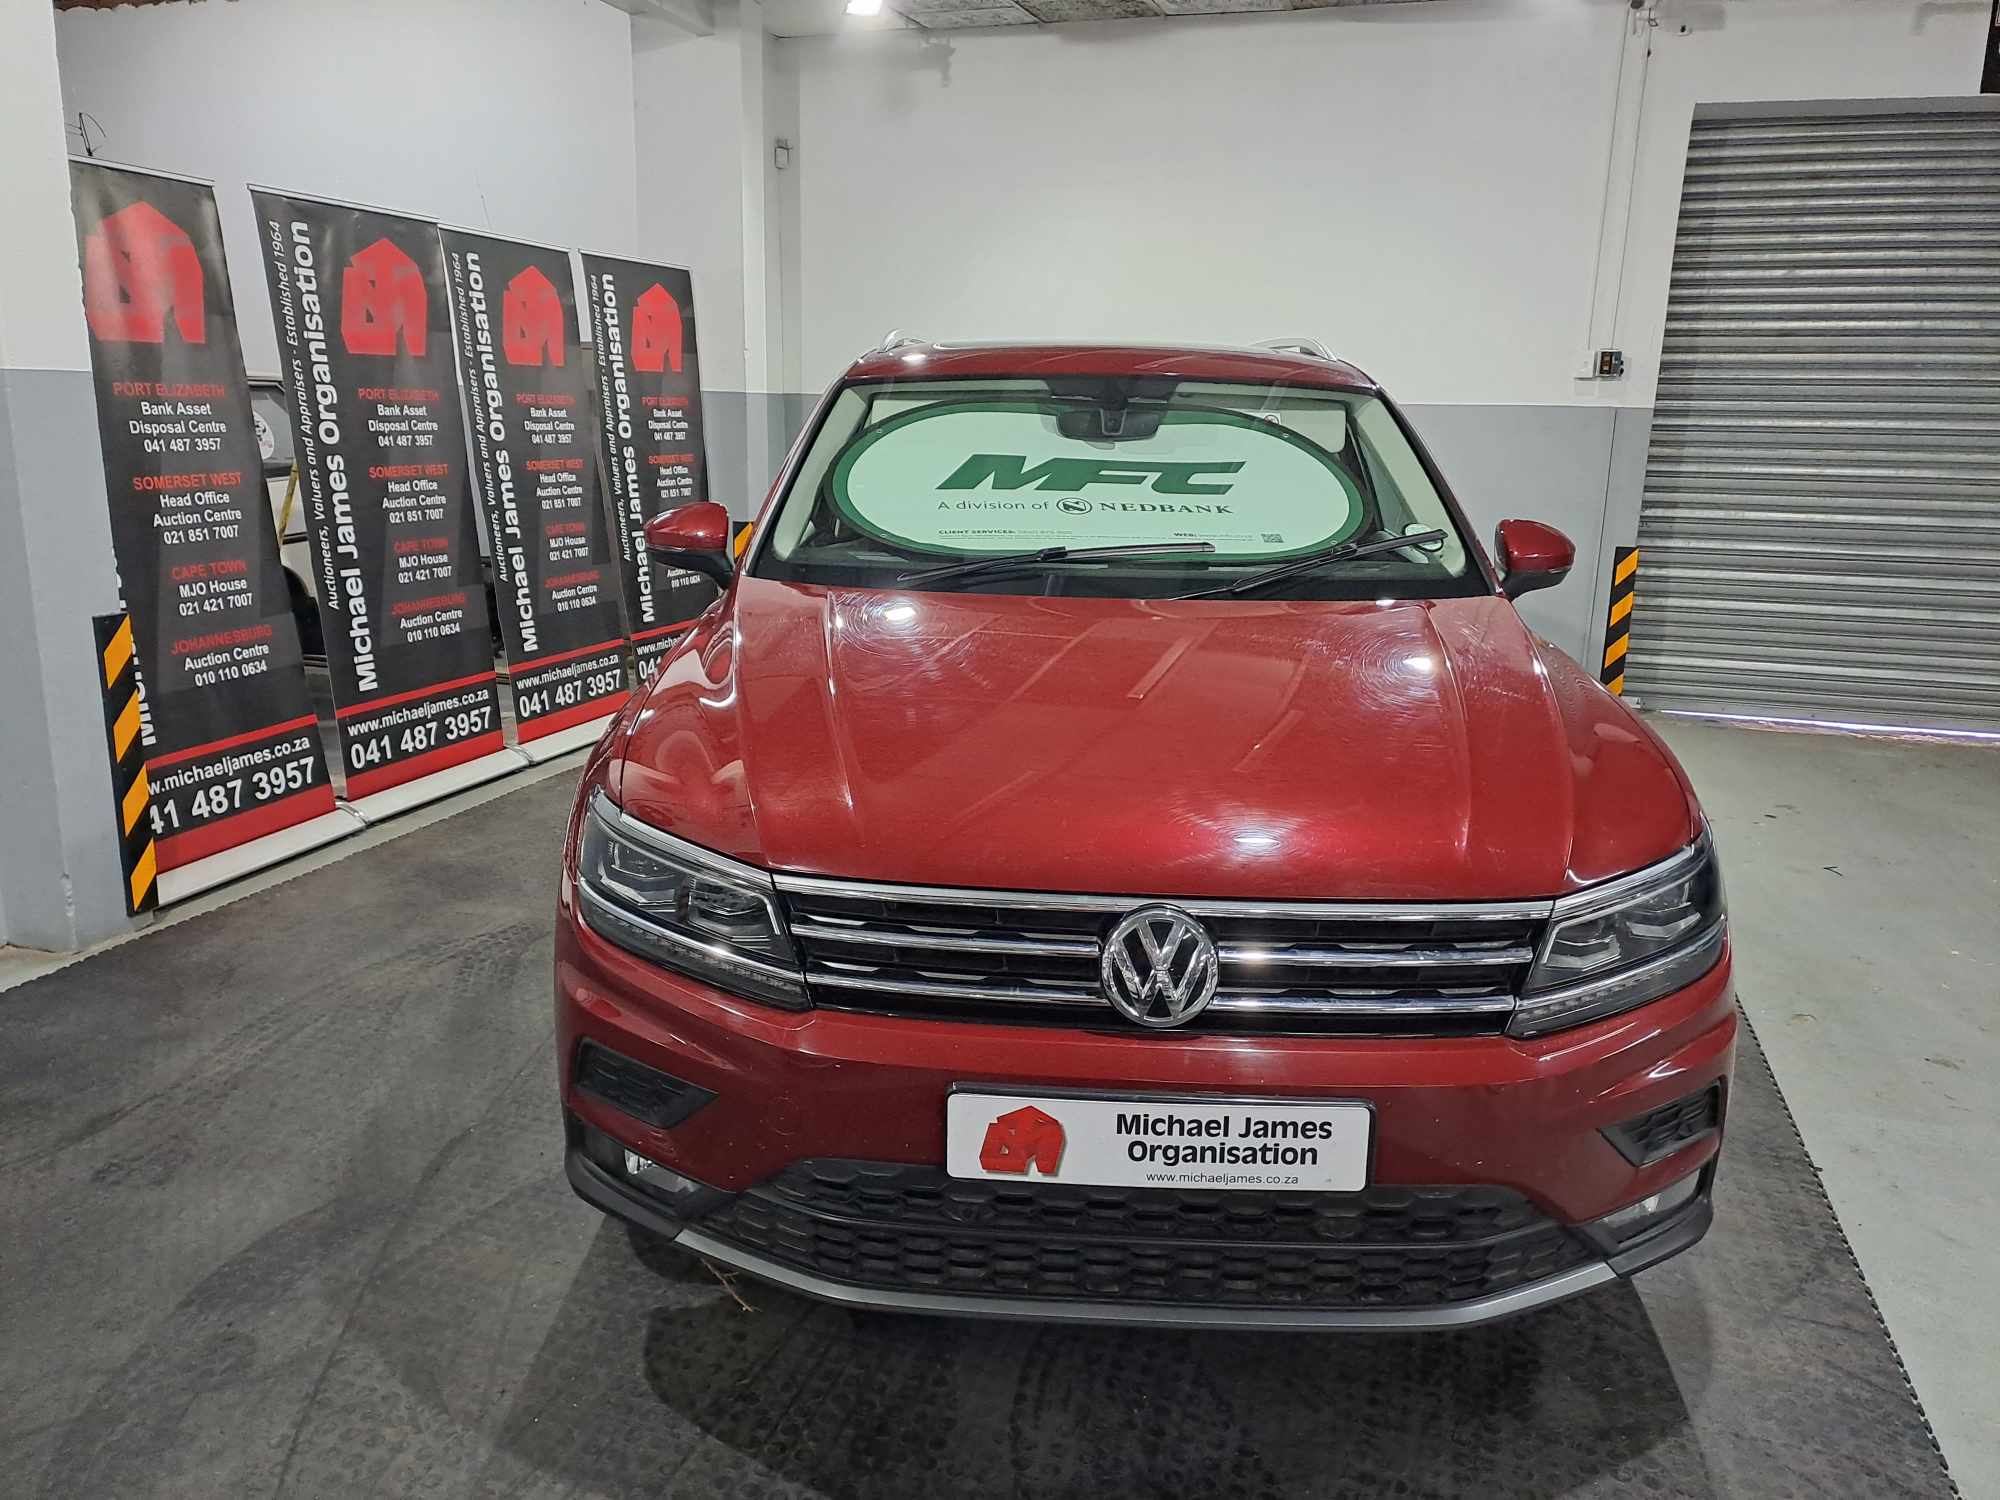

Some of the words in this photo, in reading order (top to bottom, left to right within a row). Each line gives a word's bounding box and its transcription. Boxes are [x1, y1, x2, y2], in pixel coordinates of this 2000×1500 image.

[268, 220, 283, 258] 1964
[451, 252, 465, 283] 1964
[273, 260, 298, 346] Established
[290, 221, 341, 445] Organisation
[454, 285, 474, 358] Established
[592, 302, 606, 366] Established
[466, 252, 506, 442] Organisation
[602, 273, 633, 439] Organisation
[112, 382, 151, 396] PORT
[292, 357, 313, 435] Appraisers
[358, 388, 384, 400] PORT
[469, 368, 485, 435] Appraisers
[141, 402, 174, 415] Bank
[176, 402, 212, 415] Asset
[377, 404, 401, 416] Bank
[403, 404, 428, 416] Asset
[602, 375, 614, 433] Appraisers
[129, 420, 185, 437] Disposal
[188, 420, 226, 433] Centre
[368, 419, 410, 434] Disposal
[411, 420, 439, 431] Centre
[144, 439, 166, 452] 041
[170, 438, 193, 451] 487
[195, 437, 222, 451] 3957
[305, 437, 318, 465] and
[378, 435, 394, 447] 041
[396, 435, 412, 446] 487
[415, 434, 433, 446] 3957
[479, 437, 489, 460] and
[608, 434, 617, 454] and
[132, 473, 206, 490] SOMERSET
[209, 472, 241, 486] WEST
[368, 464, 422, 478] SOMERSET
[424, 463, 449, 476] WEST
[485, 462, 499, 506] Valuers
[612, 456, 622, 495] Valuers
[935, 453, 1247, 496] MFC
[308, 466, 327, 521] Valuers
[388, 480, 411, 492] Head
[413, 479, 438, 491] Office
[496, 448, 521, 539] James
[536, 486, 561, 497] Auction
[623, 446, 643, 526] James
[160, 493, 192, 508] Head
[194, 491, 230, 505] Office
[325, 454, 359, 559] James
[382, 496, 417, 509] Auction
[419, 493, 447, 505] Centre
[937, 500, 950, 511] A
[954, 499, 1028, 511] division
[1031, 499, 1050, 511] of
[1100, 501, 1234, 515] NEDBANK
[153, 511, 202, 527] Auction
[204, 509, 242, 522] Centre
[389, 511, 405, 523] 021
[406, 510, 422, 522] 851
[425, 508, 444, 520] 7007
[163, 530, 185, 545] 021
[188, 527, 210, 542] 851
[212, 525, 239, 539] 7007
[490, 510, 508, 582] Auctioneers,
[171, 564, 209, 579] CAPE
[209, 560, 247, 574] TOWN
[316, 525, 339, 610] Auctioneers,
[398, 571, 413, 583] 021
[415, 568, 430, 580] 421
[432, 565, 452, 578] 7007
[399, 556, 418, 568] MJO
[420, 554, 448, 565] House
[179, 582, 207, 598] MJO
[209, 579, 247, 593] House
[632, 529, 655, 623] Michael
[179, 601, 200, 616] 021
[203, 597, 224, 612] 421
[227, 593, 252, 608] 7007
[508, 546, 539, 652] Michael
[552, 588, 576, 600] Auction
[340, 568, 378, 692] Michael
[400, 614, 433, 629] Auction
[435, 609, 463, 622] Centre
[407, 630, 423, 643] 010
[424, 626, 439, 638] 110
[440, 622, 461, 635] 0634
[170, 624, 272, 656] JOHANNESBURG
[184, 652, 231, 671] Auction
[233, 644, 269, 660] Centre
[194, 670, 216, 686] 010
[217, 665, 239, 681] 110
[241, 659, 267, 676] 0634
[516, 654, 619, 690] www.michaeljames.co.za
[519, 689, 550, 718] 041
[555, 680, 582, 706] 487
[586, 669, 621, 696] 3957
[347, 689, 489, 737] www.michaeljames.co.za
[350, 734, 392, 769] 041
[400, 721, 438, 753] 487
[444, 705, 491, 740] 3957
[191, 778, 242, 819] 487
[252, 756, 314, 800] 3957
[1116, 1113, 1230, 1138] Michael
[1238, 1116, 1333, 1140] James
[1128, 1141, 1318, 1167] Organisation
[1145, 1171, 1299, 1186] www.michaeljames.co.za
